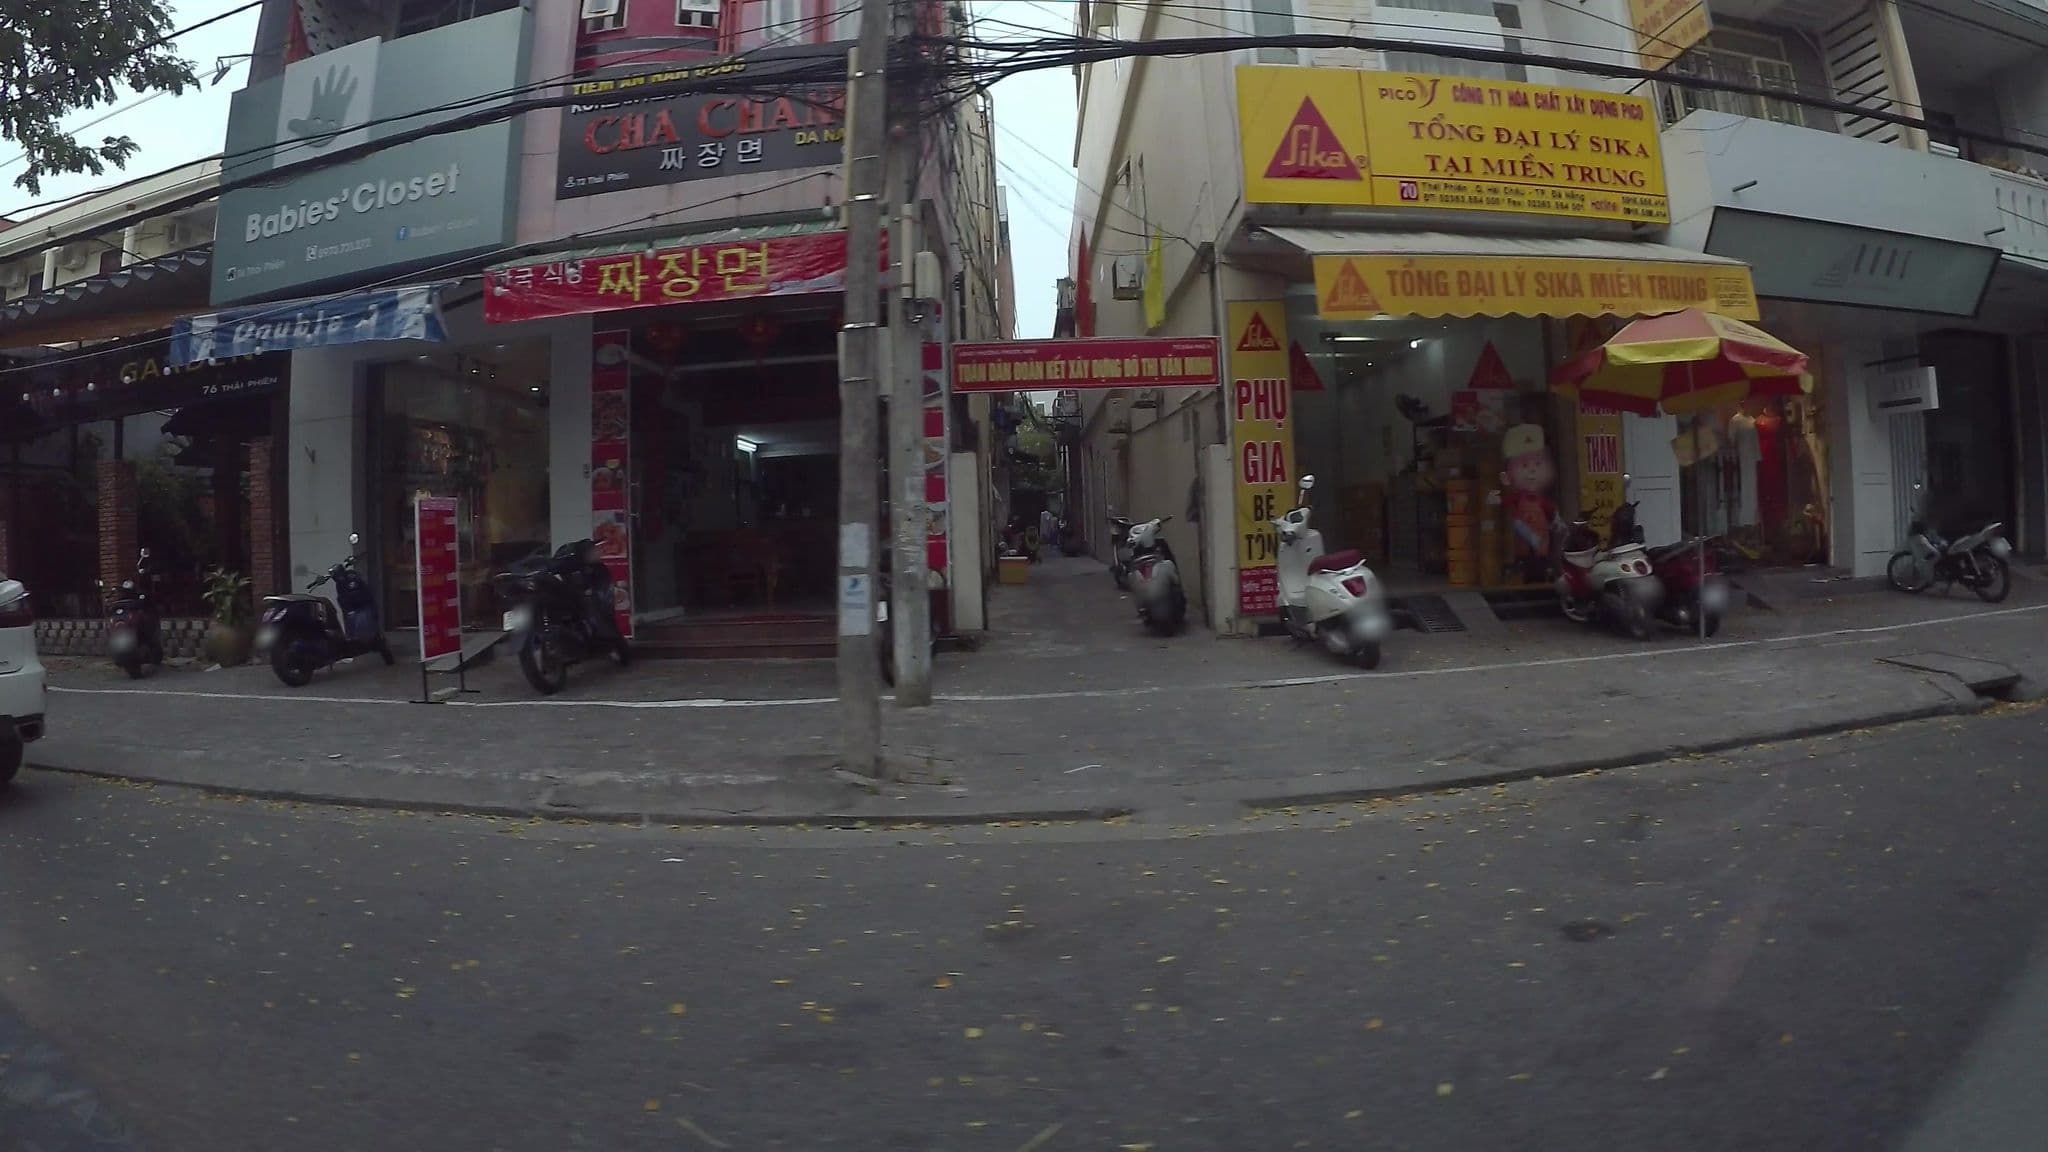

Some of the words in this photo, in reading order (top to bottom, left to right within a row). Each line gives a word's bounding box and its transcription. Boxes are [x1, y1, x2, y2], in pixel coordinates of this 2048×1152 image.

[1377, 87, 1417, 101] PICO
[1488, 88, 1502, 106] TY
[583, 107, 681, 154] CHA
[696, 85, 847, 138] CHAN
[1408, 113, 1485, 143] TỔNG
[1494, 126, 1542, 149] ĐẠI
[1550, 129, 1581, 151] LÝ
[1588, 135, 1650, 158] SIKA
[1281, 124, 1347, 168] Sika
[352, 163, 460, 214] Closet
[1400, 182, 1418, 199] 70
[1424, 154, 1473, 176] TẠI
[1481, 153, 1555, 179] MIỀN
[1561, 163, 1646, 188] TRUNG
[597, 241, 770, 302] 짜장면
[1386, 258, 1450, 297] TỔNG
[1456, 269, 1496, 303] ĐẠI
[1502, 265, 1527, 297] LÝ
[1535, 270, 1585, 298] SIKA
[1648, 274, 1708, 302] TRUNG
[202, 384, 218, 395] 76
[1235, 377, 1287, 430] PHỤ
[1242, 440, 1288, 484] GIA
[1253, 488, 1276, 522] BÊ
